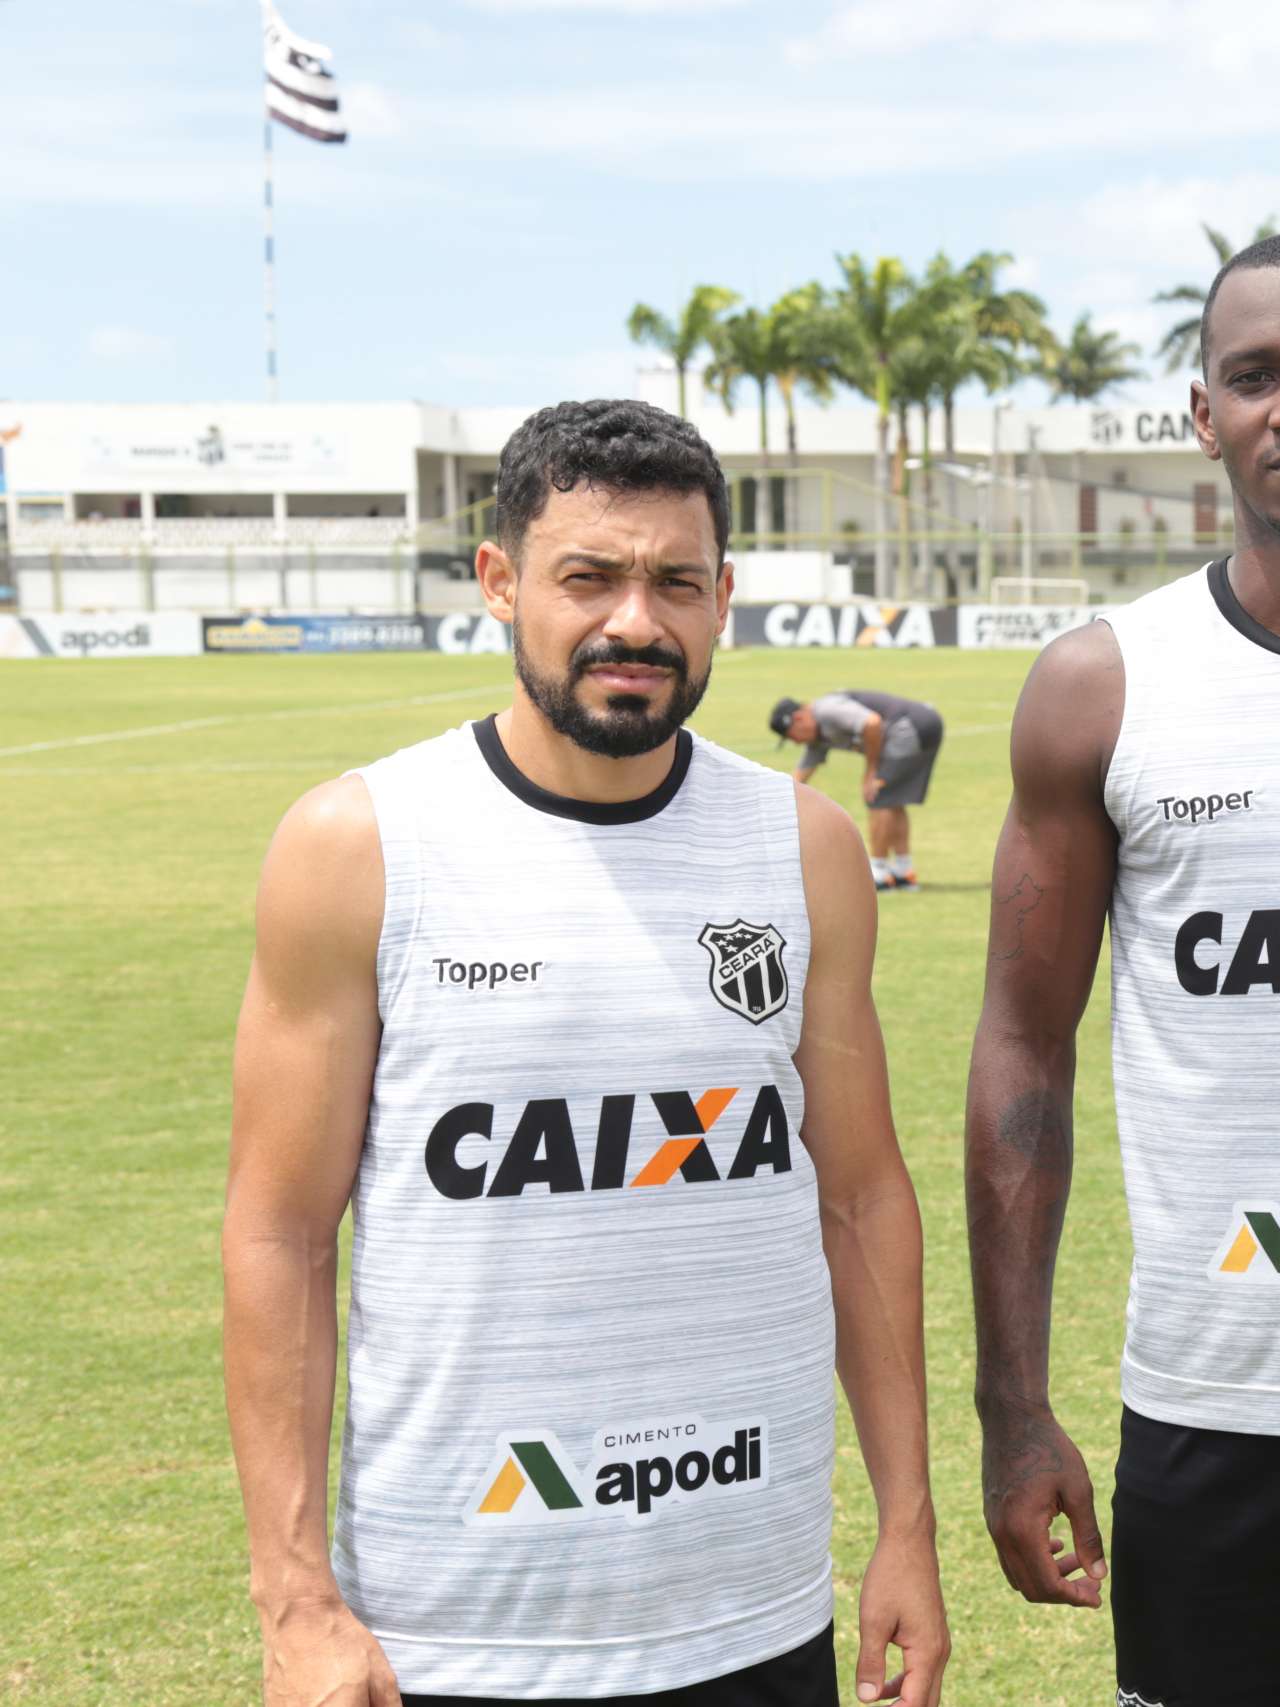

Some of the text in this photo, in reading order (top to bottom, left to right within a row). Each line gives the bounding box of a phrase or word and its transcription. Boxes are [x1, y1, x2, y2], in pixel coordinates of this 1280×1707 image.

[62, 624, 150, 657] apodi
[764, 602, 936, 648] CAIXA
[1157, 790, 1253, 822] Topper
[432, 958, 543, 990] Topper
[425, 1085, 792, 1200] CAIXA
[604, 1423, 697, 1448] CIMENTO
[595, 1426, 761, 1514] apodi
